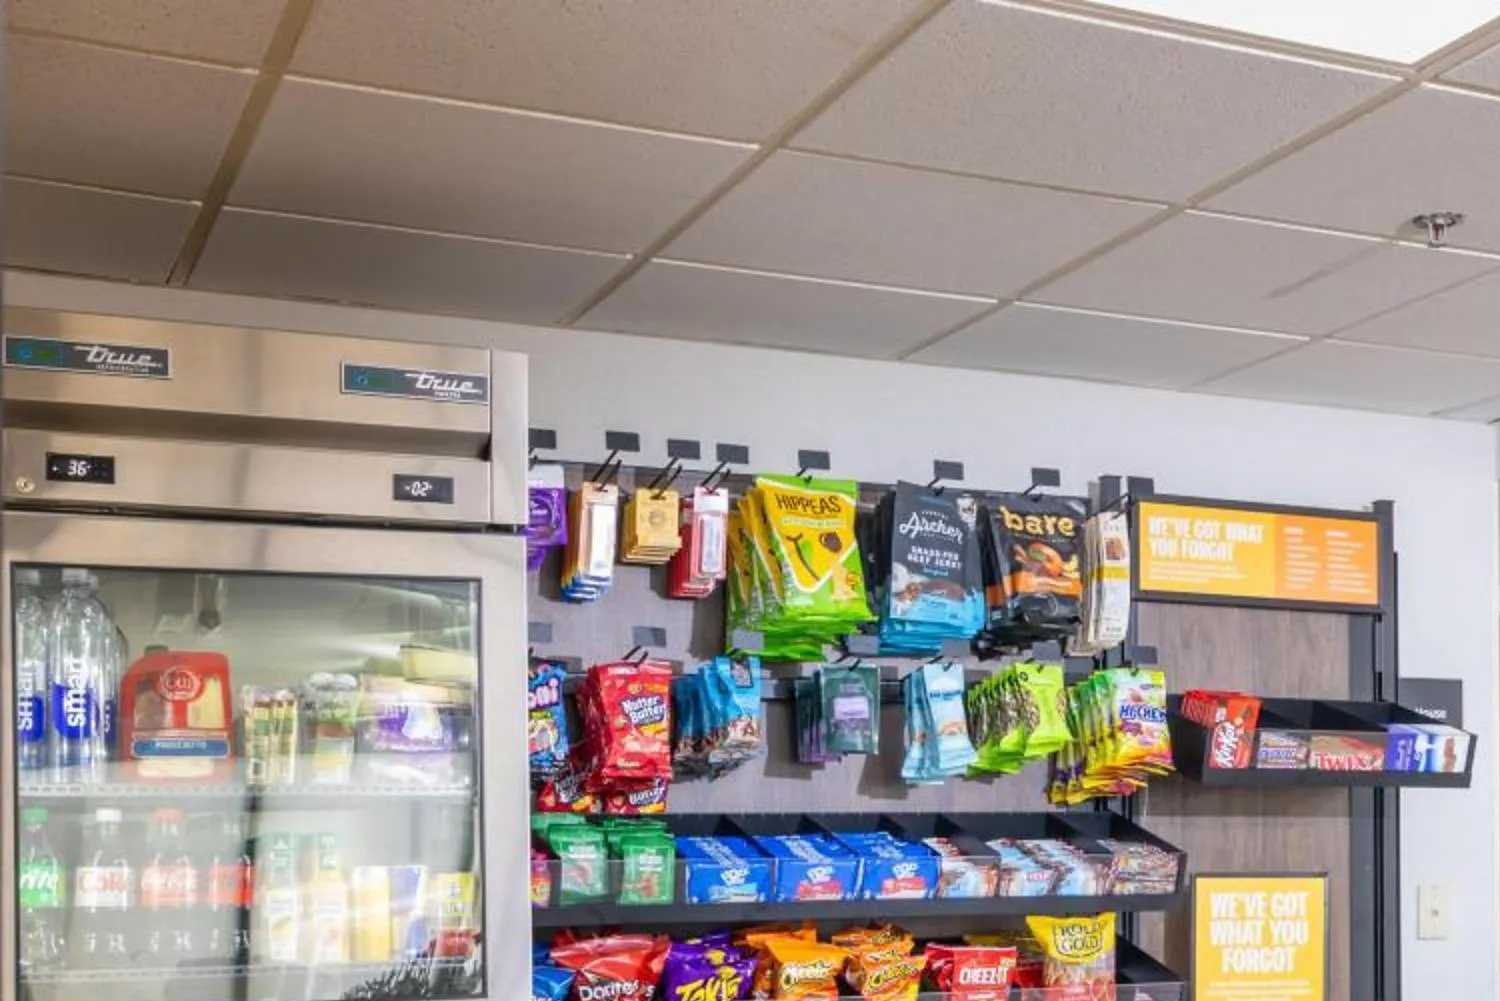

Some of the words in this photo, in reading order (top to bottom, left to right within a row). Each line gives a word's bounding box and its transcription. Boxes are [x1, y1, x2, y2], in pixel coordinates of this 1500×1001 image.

[774, 493, 842, 514] HIPPEAS
[899, 511, 963, 544] Archer
[999, 505, 1075, 536] bare
[1148, 516, 1191, 537] WE'VE
[1194, 520, 1220, 540] GOT
[1225, 522, 1264, 544] WHAT
[1150, 538, 1177, 557] YOU
[1181, 541, 1234, 561] FORGOT
[621, 695, 659, 712] Nutter
[630, 705, 667, 723] Butter
[1210, 891, 1267, 918] WE'VE
[1271, 891, 1310, 917] GOT
[1061, 936, 1101, 952] GOLD
[1210, 919, 1264, 946] WHAT
[1271, 919, 1309, 945] YOU
[1221, 947, 1296, 974] FORGOT
[959, 966, 1009, 985] CHEEZ-IT
